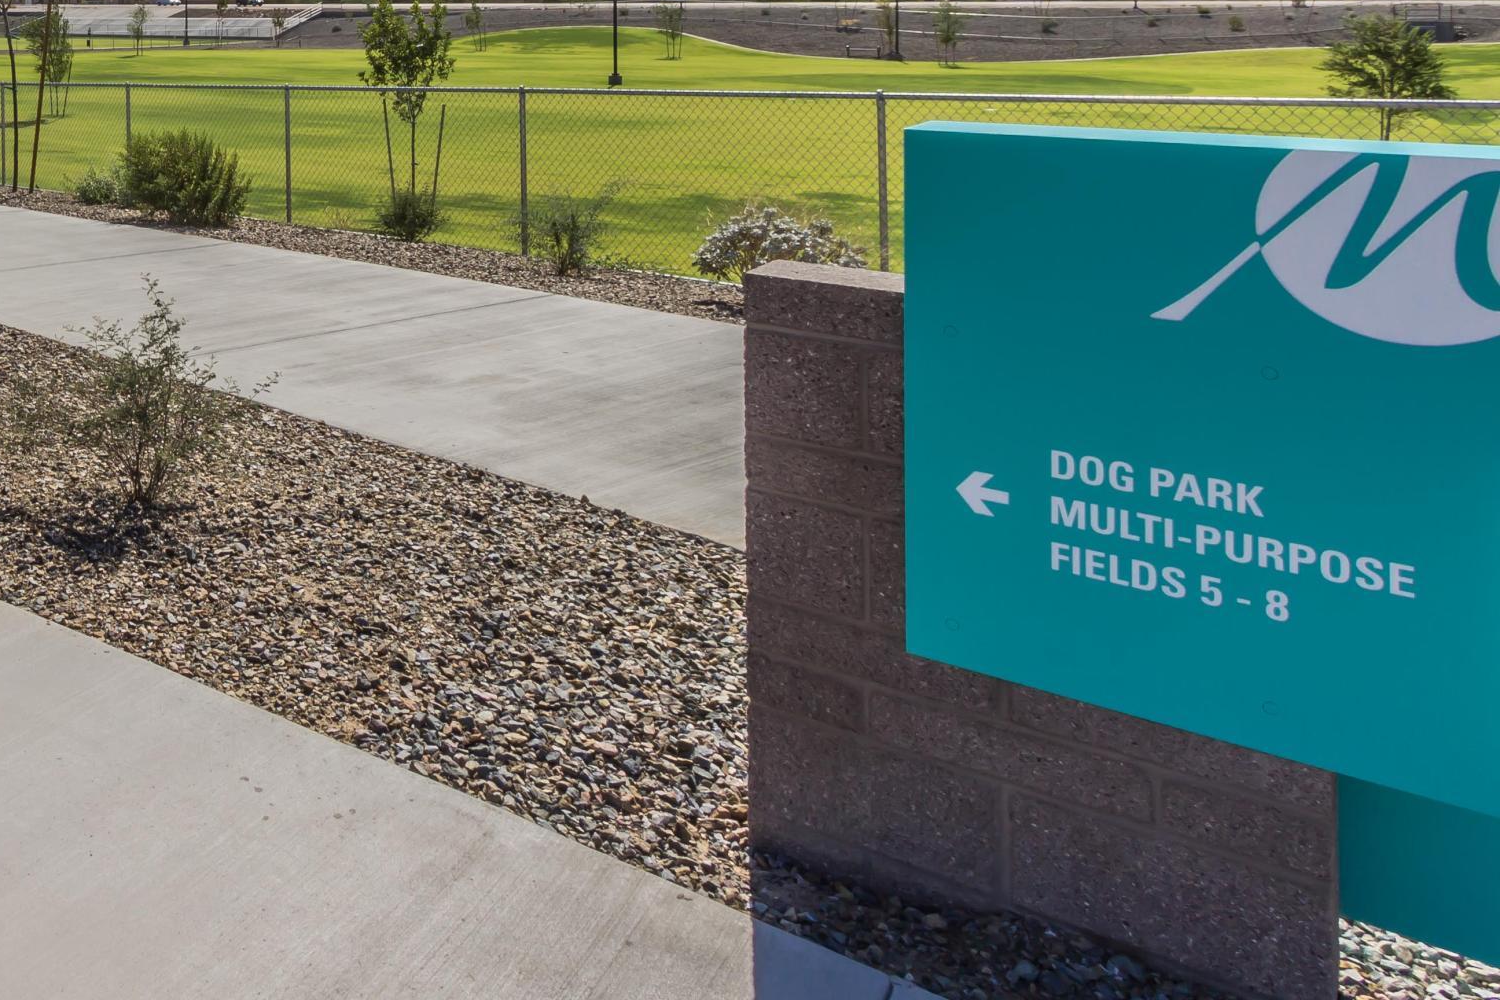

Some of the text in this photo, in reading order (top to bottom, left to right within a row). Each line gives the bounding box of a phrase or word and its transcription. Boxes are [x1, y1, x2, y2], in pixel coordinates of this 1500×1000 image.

[1050, 449, 1264, 517] DOG PARK
[1050, 495, 1415, 599] MULTI-PURPOSE
[1050, 542, 1186, 599] FIELDS
[1200, 575, 1223, 607] 5
[1265, 590, 1289, 622] 8
